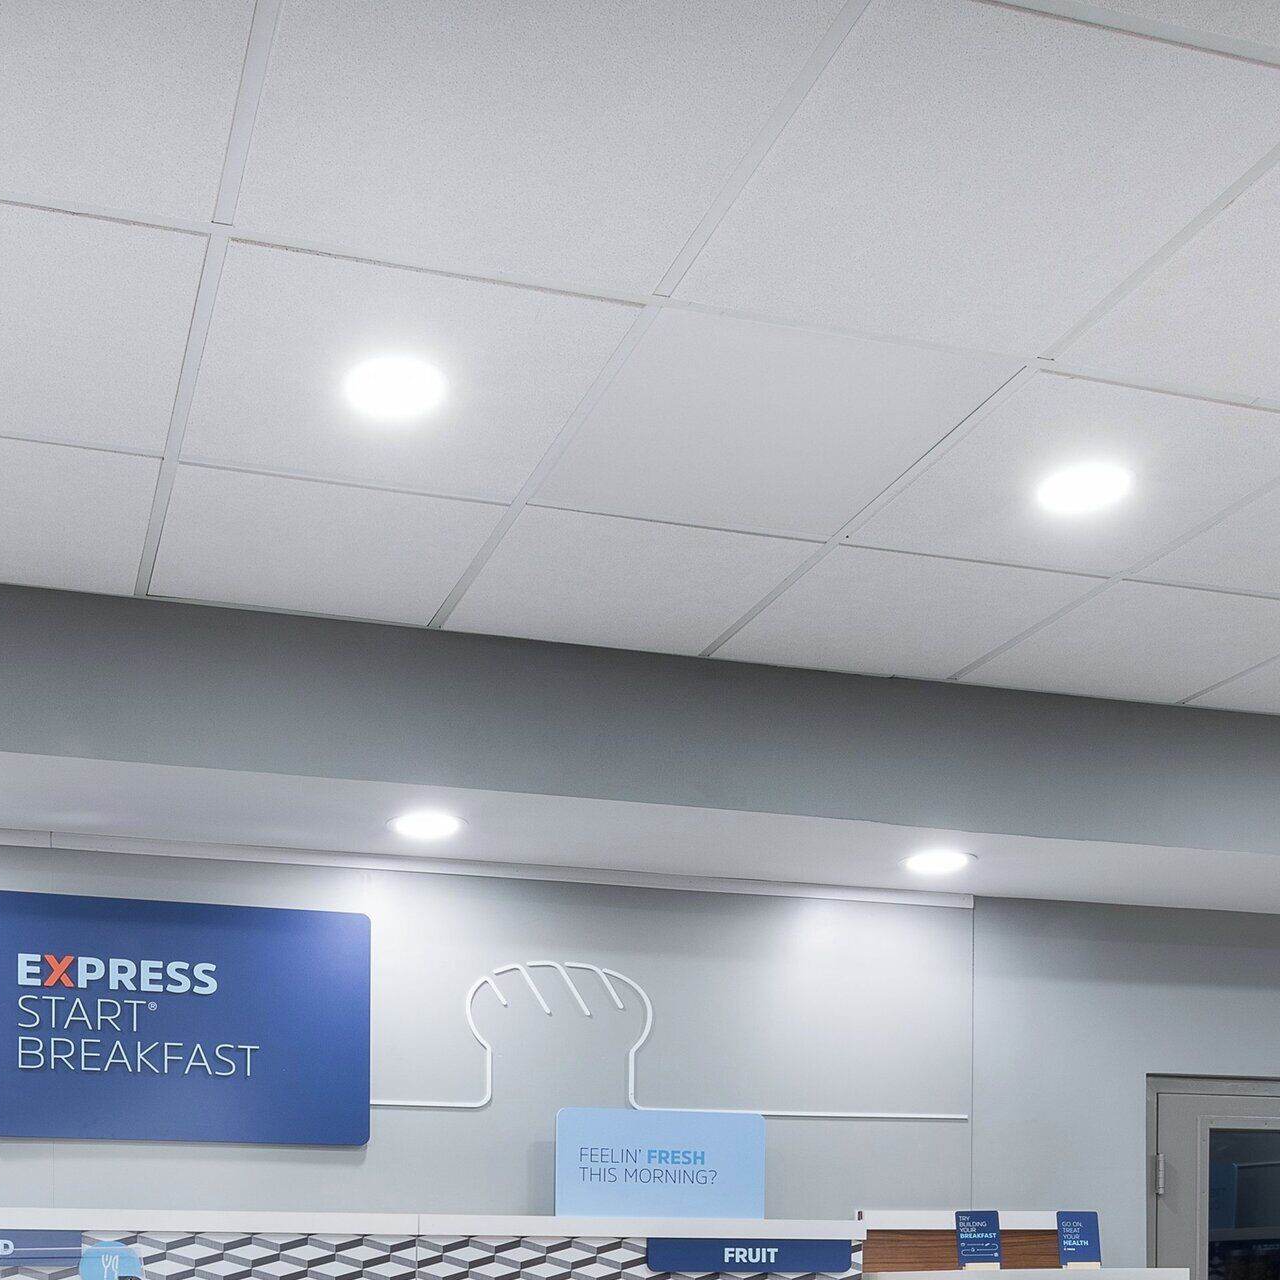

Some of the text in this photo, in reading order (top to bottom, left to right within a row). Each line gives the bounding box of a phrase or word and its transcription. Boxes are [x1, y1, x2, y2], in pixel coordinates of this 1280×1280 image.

[17, 952, 218, 995] EXPRESS
[18, 1036, 260, 1077] BREAKFAST
[578, 1146, 705, 1166] FEELIN' FRESH
[579, 1166, 718, 1186] THIS MORNING?
[723, 1247, 779, 1264] FRUIT
